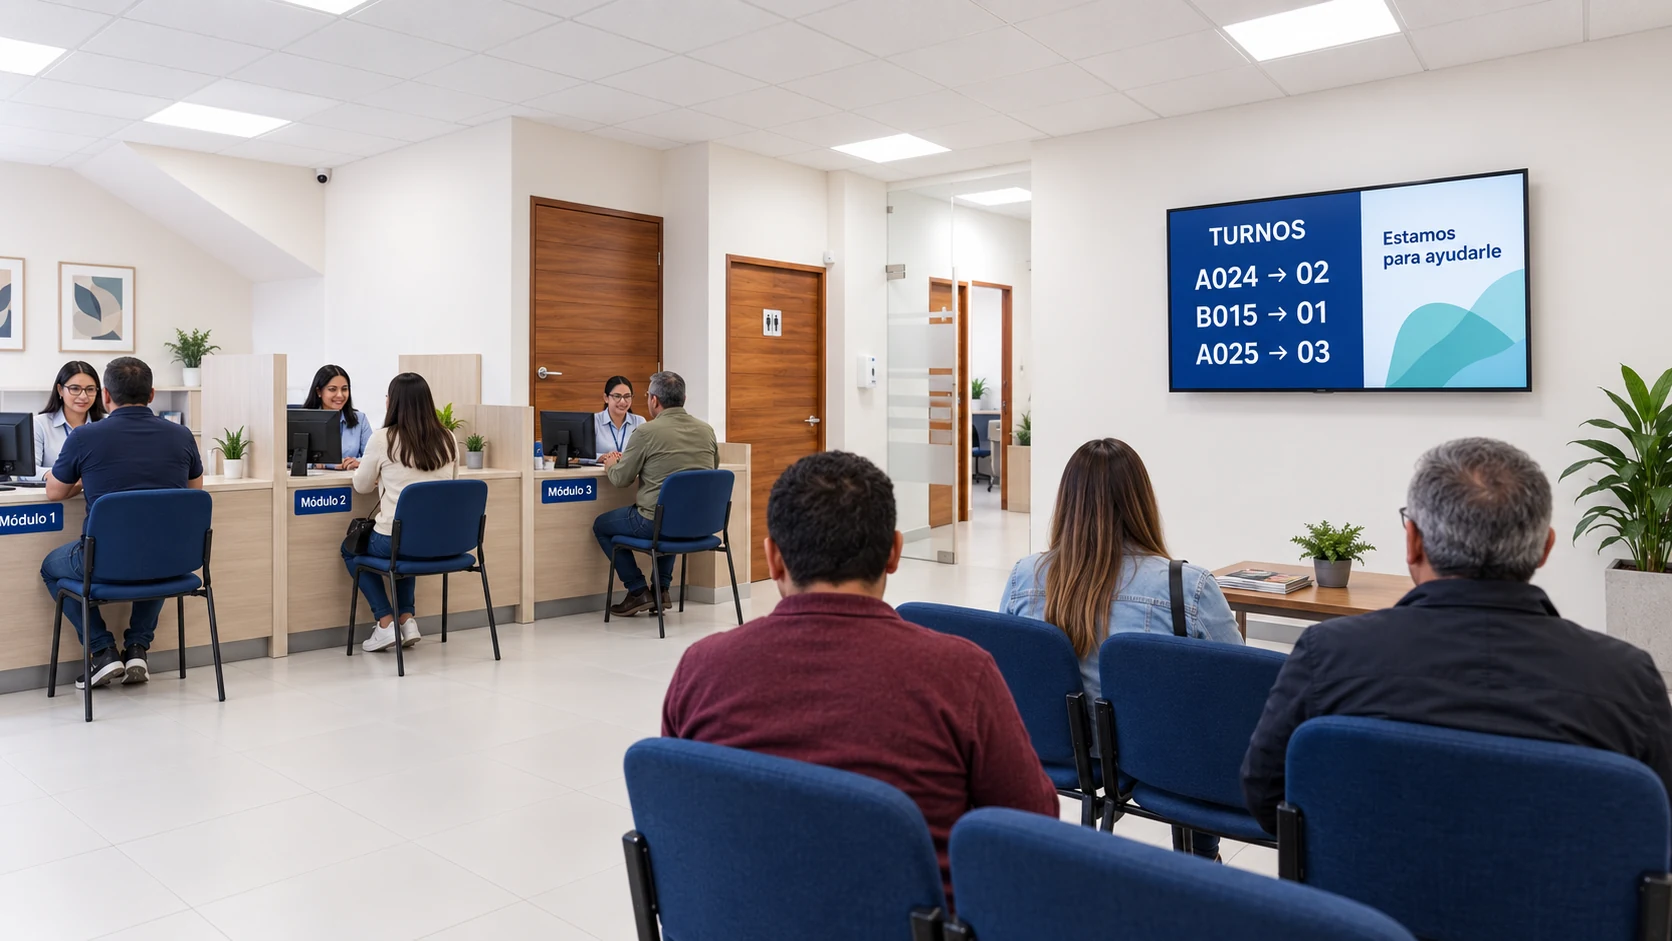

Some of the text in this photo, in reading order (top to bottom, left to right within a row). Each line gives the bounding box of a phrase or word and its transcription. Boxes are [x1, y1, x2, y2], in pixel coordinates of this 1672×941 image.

[1208, 219, 1306, 247] TURNOS
[1383, 228, 1456, 246] Estamos
[1383, 243, 1502, 270] para ayudarle
[1194, 260, 1330, 291] A024 02
[1196, 300, 1327, 328] B015 01
[1195, 340, 1330, 365] A025 03
[301, 495, 346, 508] Módulo 2
[548, 485, 592, 497] Módulo 3
[0, 512, 55, 527] Módulo 1
